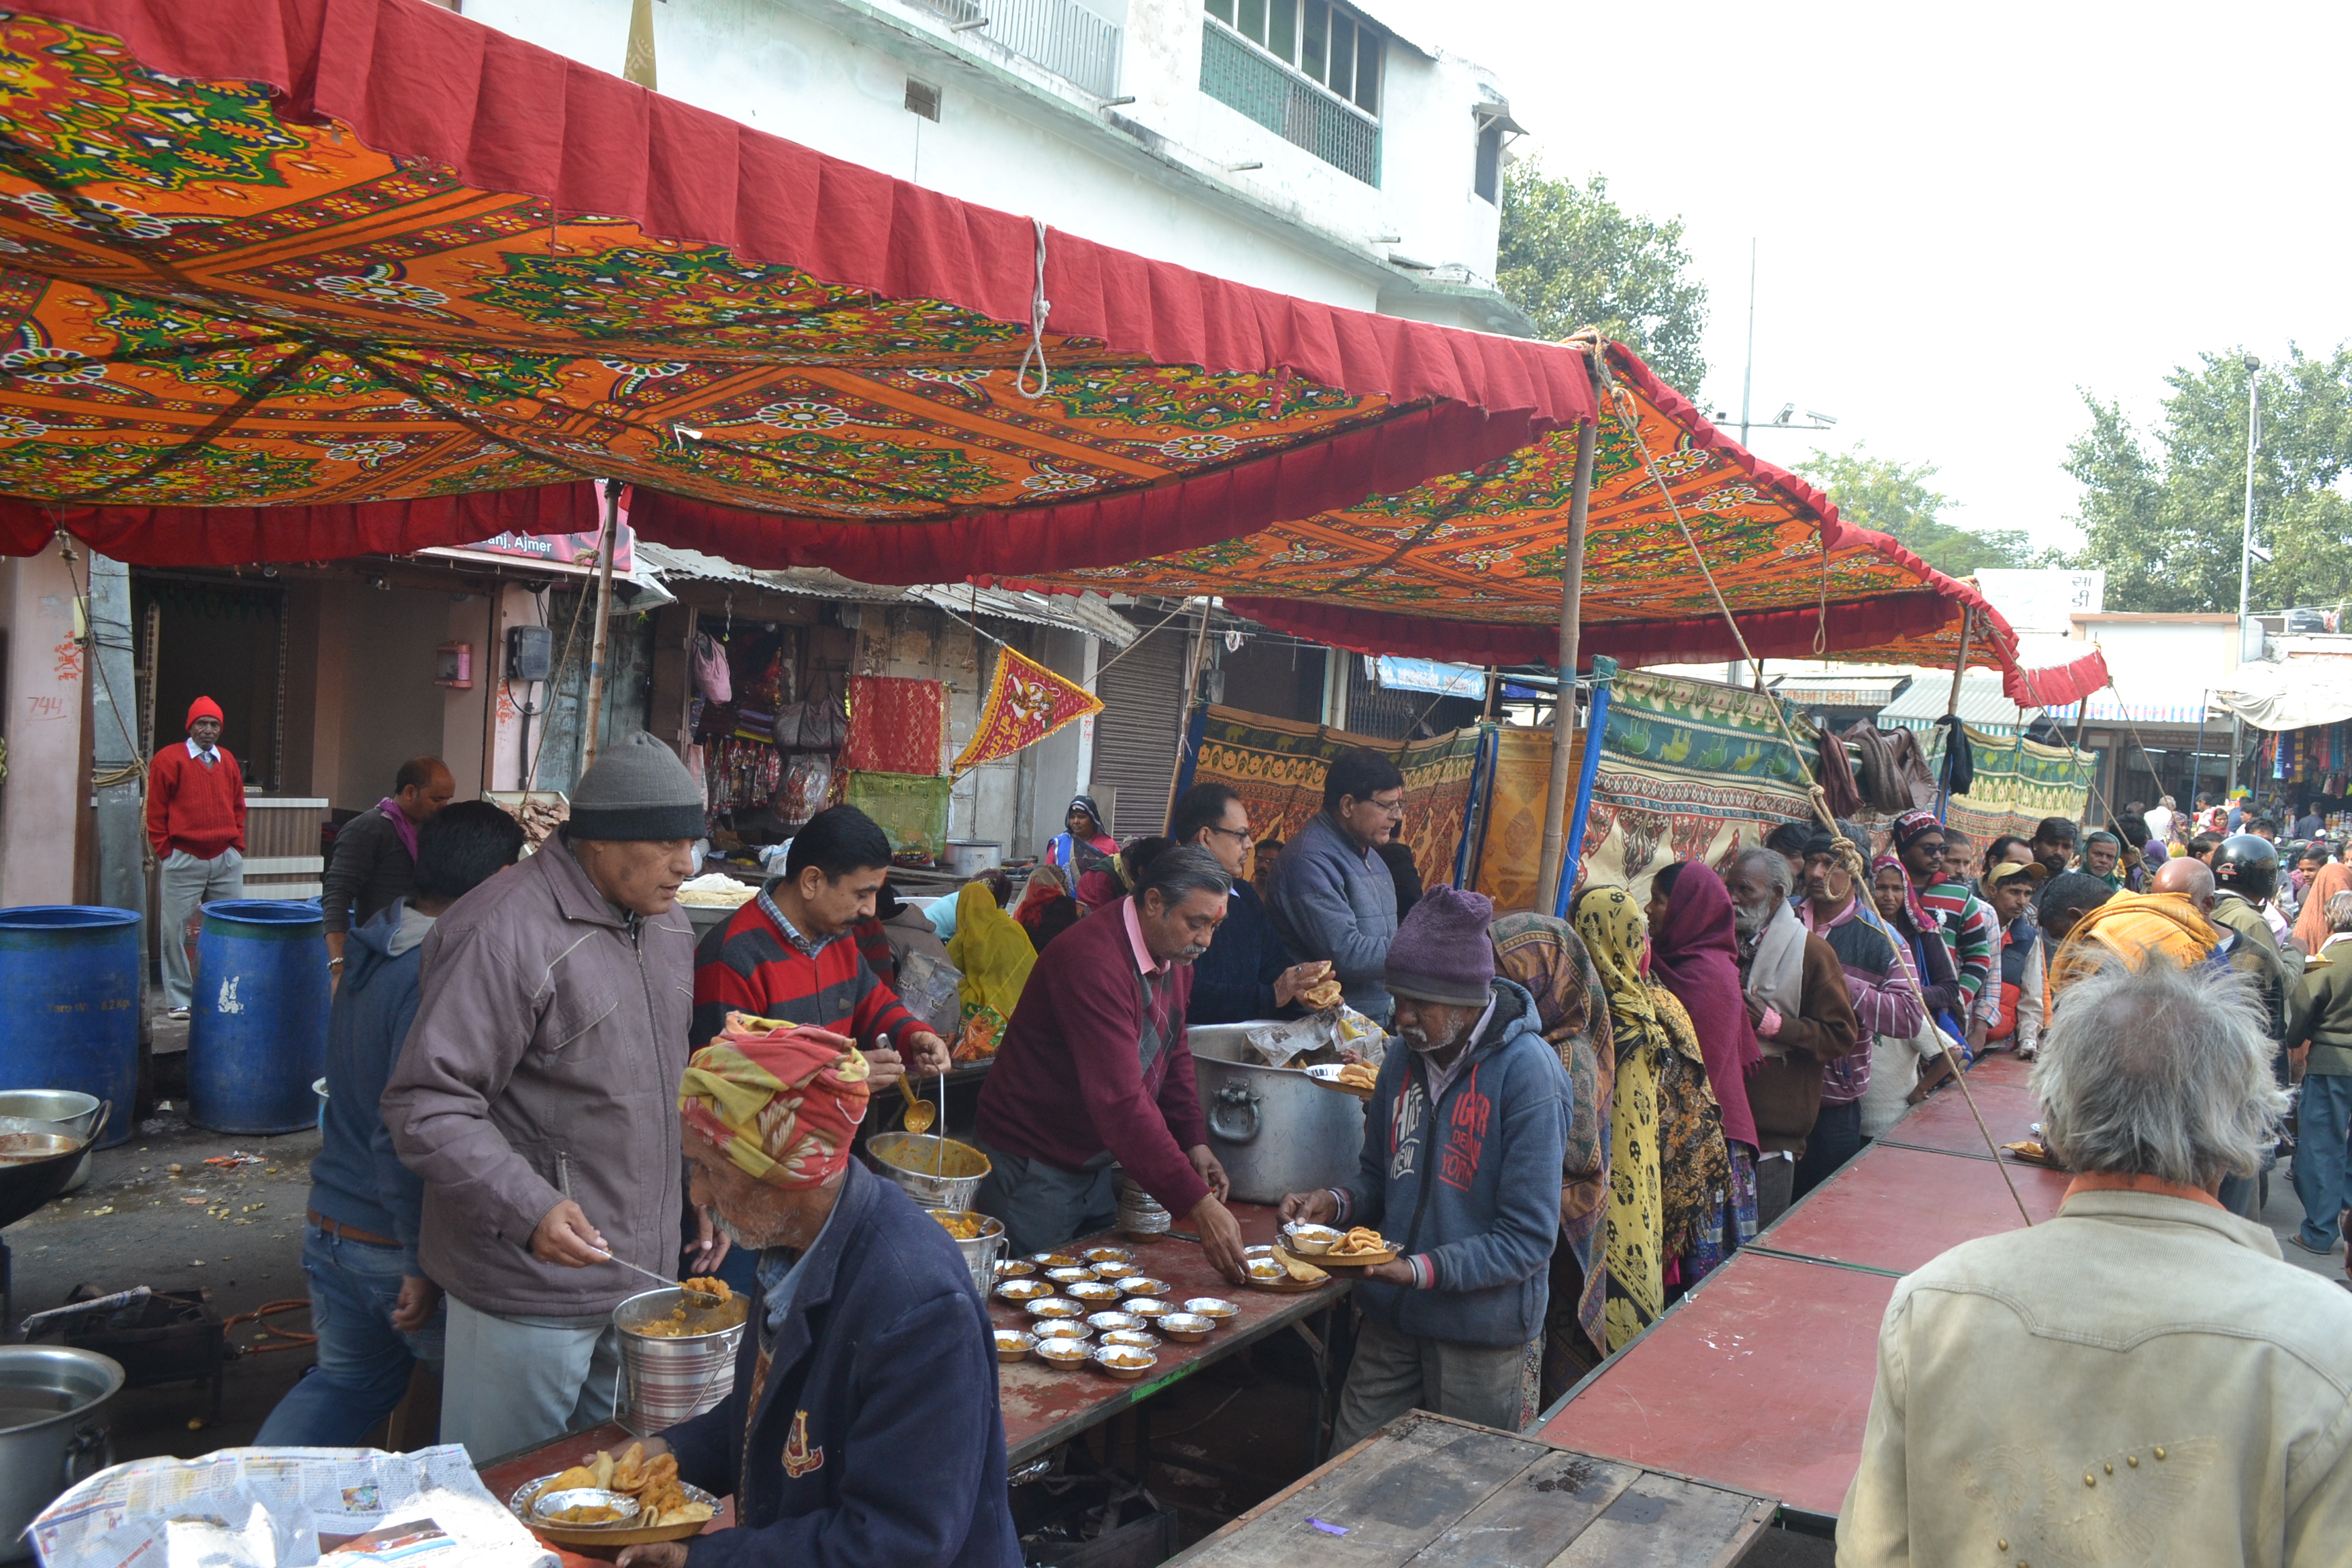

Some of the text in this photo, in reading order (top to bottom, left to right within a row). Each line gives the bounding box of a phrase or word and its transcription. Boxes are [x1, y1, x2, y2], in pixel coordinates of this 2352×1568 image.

[514, 537, 552, 553] Ajmer
[984, 715, 1011, 760] श्री राम
[1008, 723, 1023, 749] जय
[1392, 1089, 1424, 1145] HILF
[1390, 1145, 1475, 1189] NEW YORK
